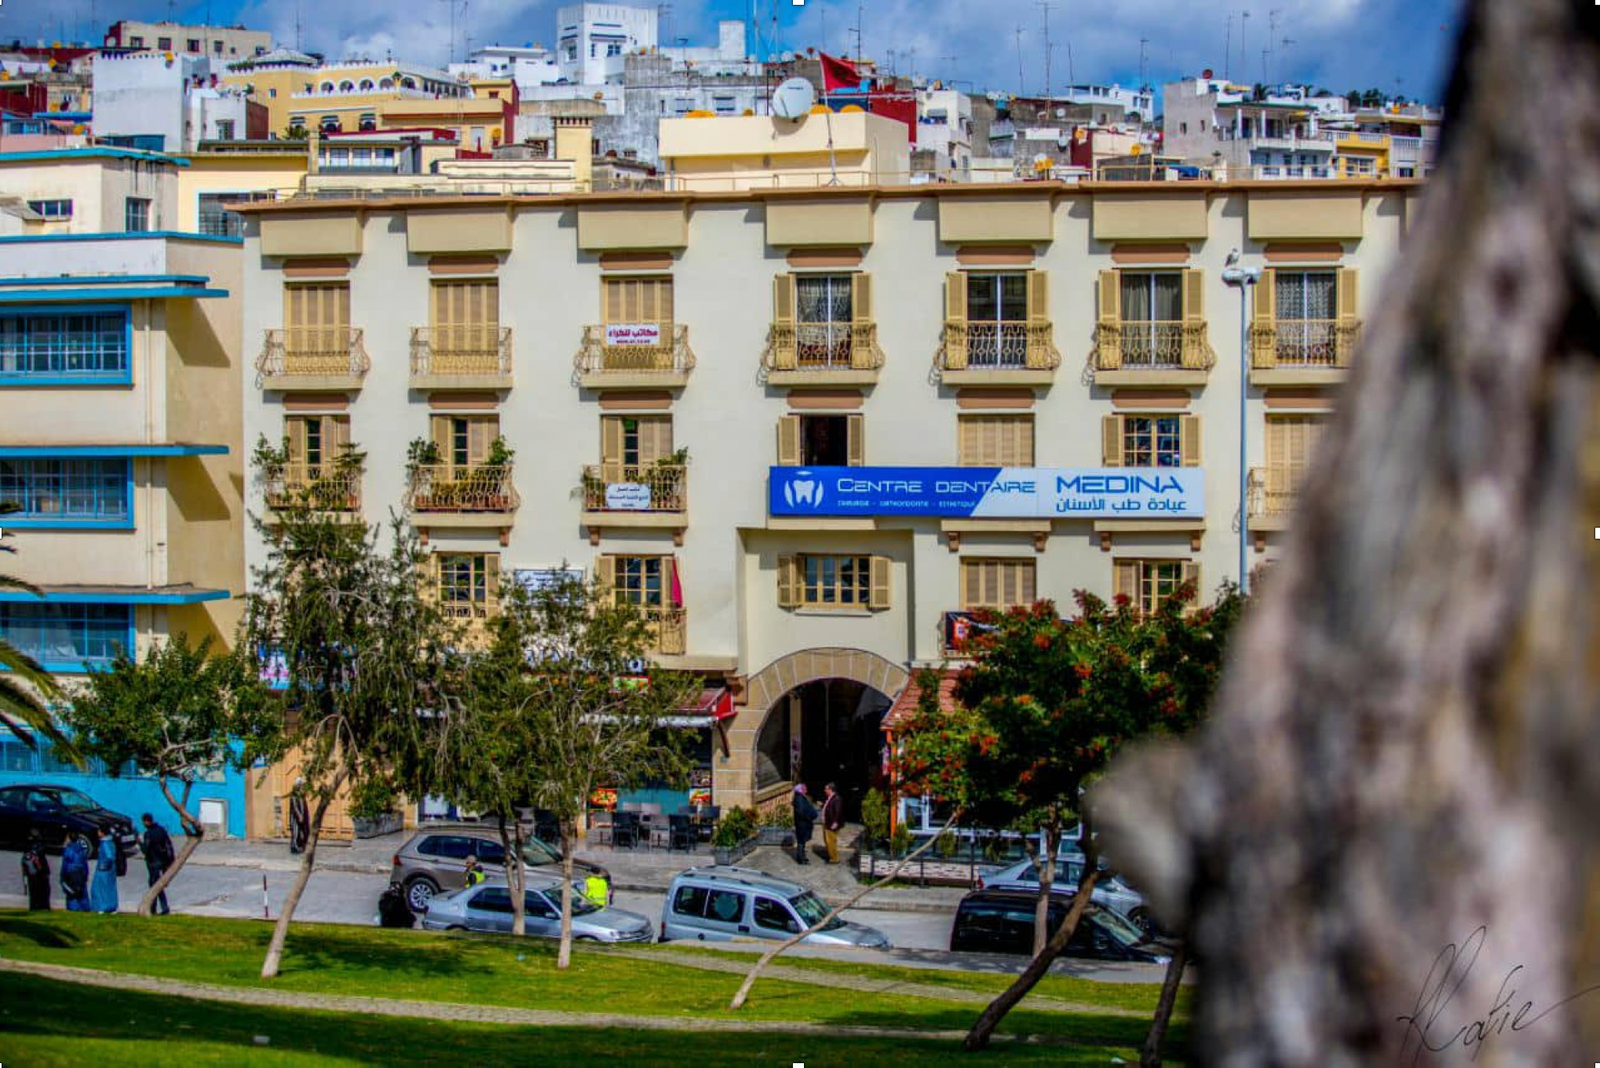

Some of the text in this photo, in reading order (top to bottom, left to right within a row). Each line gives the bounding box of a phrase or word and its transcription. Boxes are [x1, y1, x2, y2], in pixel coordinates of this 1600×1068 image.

[608, 328, 658, 338] مكاتب للكراء
[1056, 476, 1184, 494] MEDINA
[1056, 496, 1187, 514] عيادة طب الأسنان
